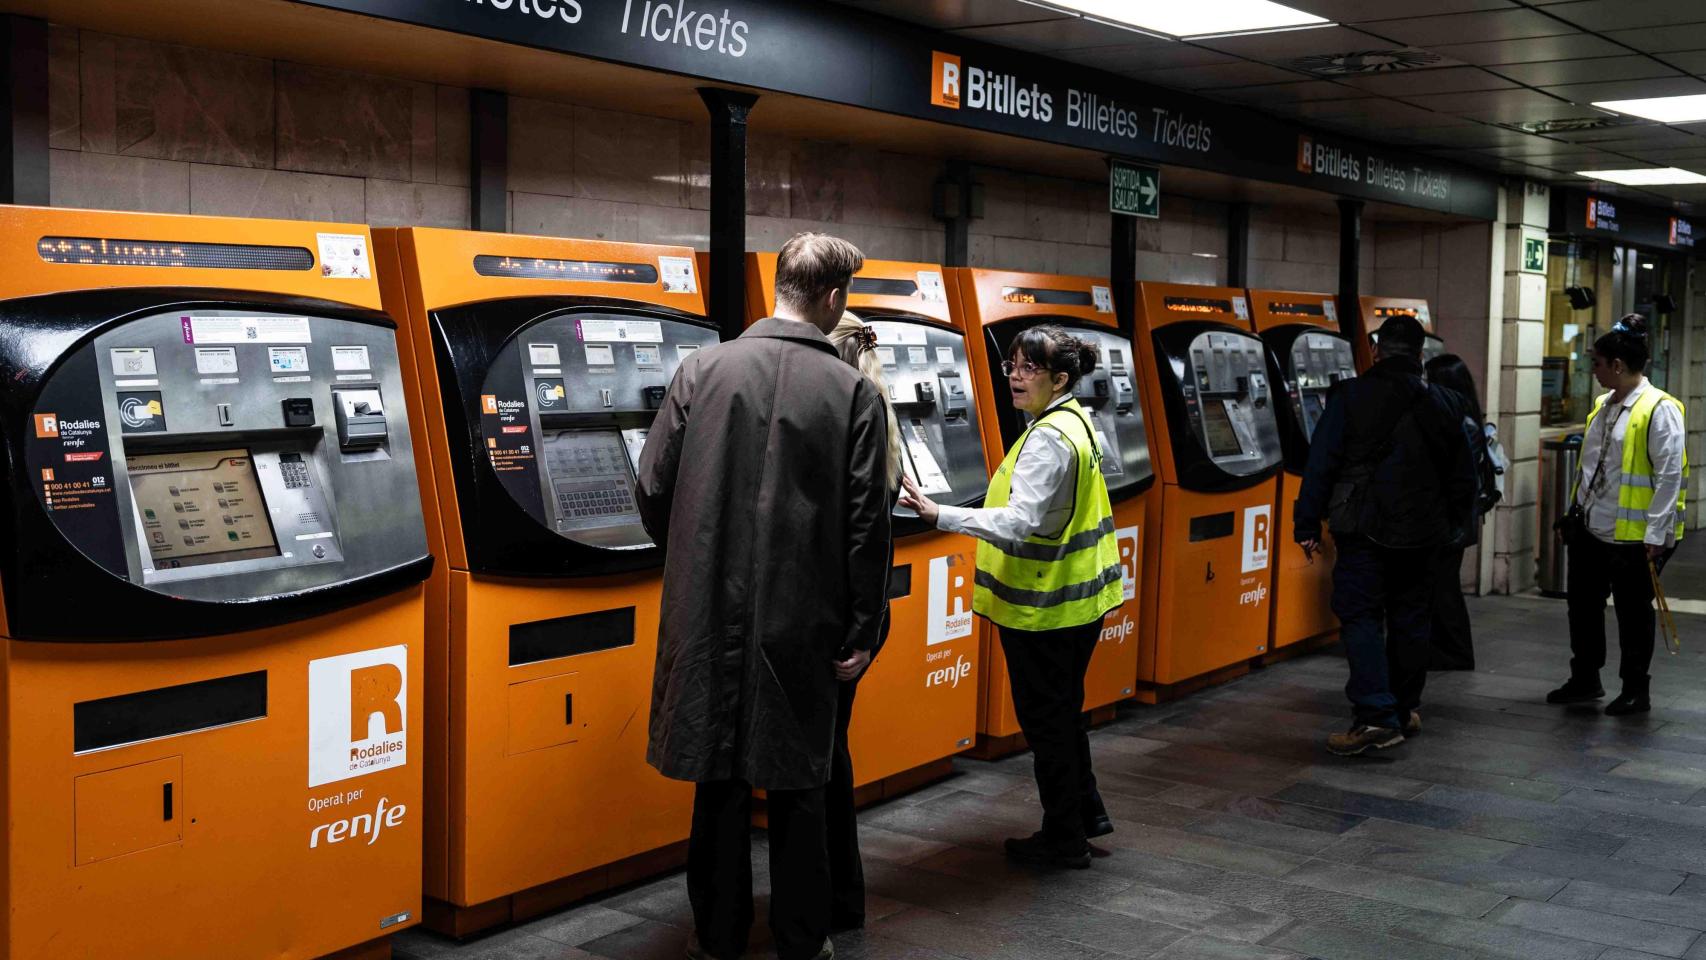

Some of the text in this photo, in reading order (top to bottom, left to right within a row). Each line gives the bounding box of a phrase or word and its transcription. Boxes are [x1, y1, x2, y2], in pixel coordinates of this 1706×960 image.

[620, 0, 750, 57] Tickets
[967, 66, 1053, 122] Bitllets
[1067, 88, 1138, 138] Billetes
[1152, 108, 1211, 151] Tickets
[1114, 167, 1140, 189] SORTIDA
[1315, 144, 1360, 181] Bitllets
[1366, 156, 1406, 191] Billetes
[1413, 167, 1448, 199] Tickets
[1114, 189, 1138, 211] SALIDA
[498, 400, 525, 408] Rodalies
[60, 420, 100, 430] Rodalies
[63, 438, 85, 448] renfe
[1240, 582, 1267, 608] renfe
[1099, 614, 1134, 644] renfe
[926, 654, 971, 688] renfe
[350, 663, 403, 743] R
[350, 740, 403, 761] Rodalies
[360, 755, 391, 769] Catalunya
[308, 788, 364, 812] Operat per
[309, 797, 406, 849] renfe
